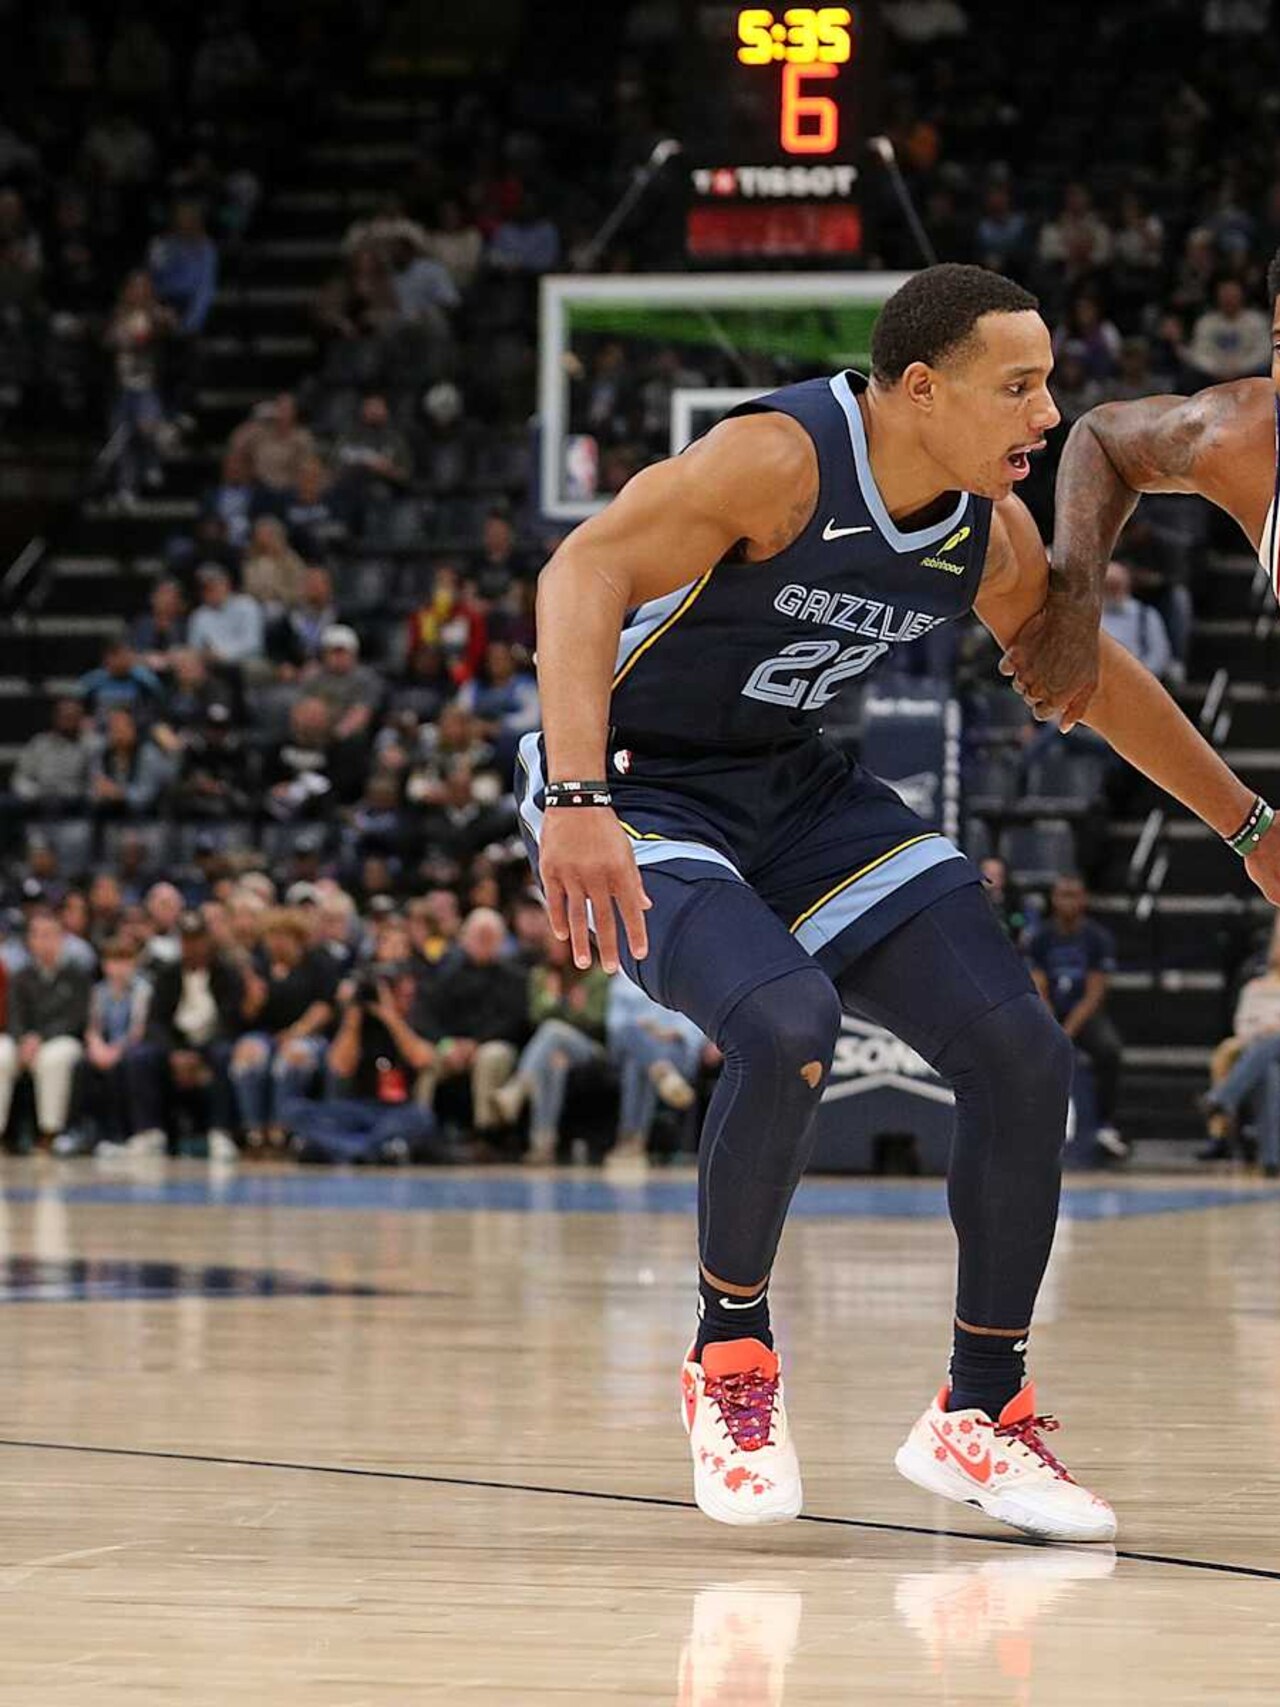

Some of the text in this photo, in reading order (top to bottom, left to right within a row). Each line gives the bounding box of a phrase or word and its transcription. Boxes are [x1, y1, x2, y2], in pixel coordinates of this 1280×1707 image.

[737, 8, 850, 65] 5:35
[781, 62, 839, 154] 6
[738, 165, 857, 198] TISSOT
[741, 639, 889, 711] 22
